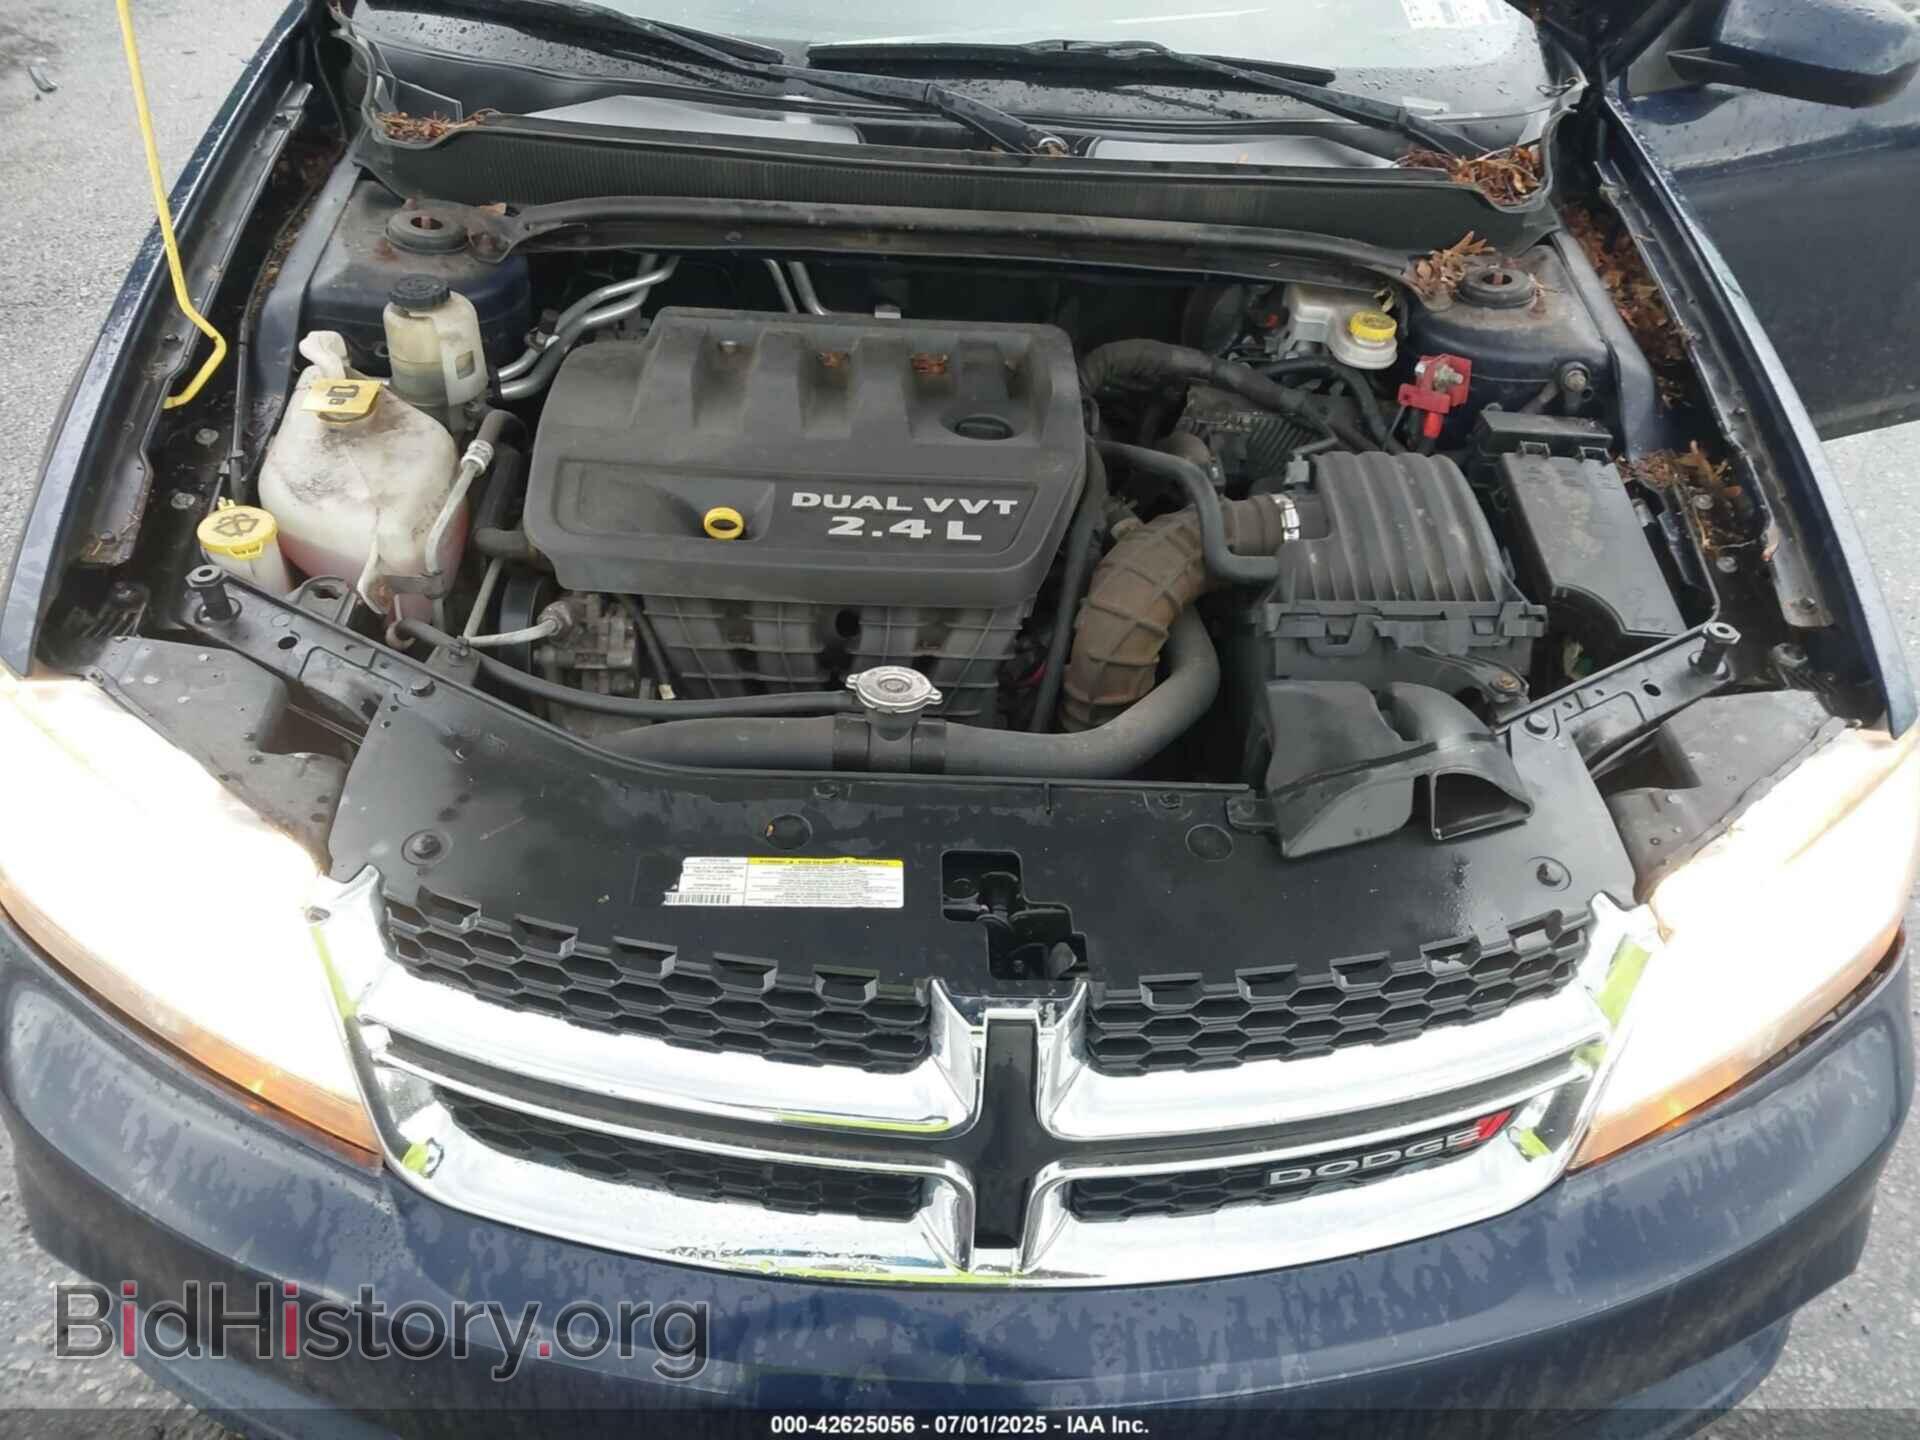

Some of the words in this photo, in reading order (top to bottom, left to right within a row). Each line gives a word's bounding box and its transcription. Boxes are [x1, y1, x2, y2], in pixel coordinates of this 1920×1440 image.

[792, 492, 912, 511] DUAL
[923, 497, 1018, 515] VVT
[1269, 1125, 1482, 1185] DODGE
